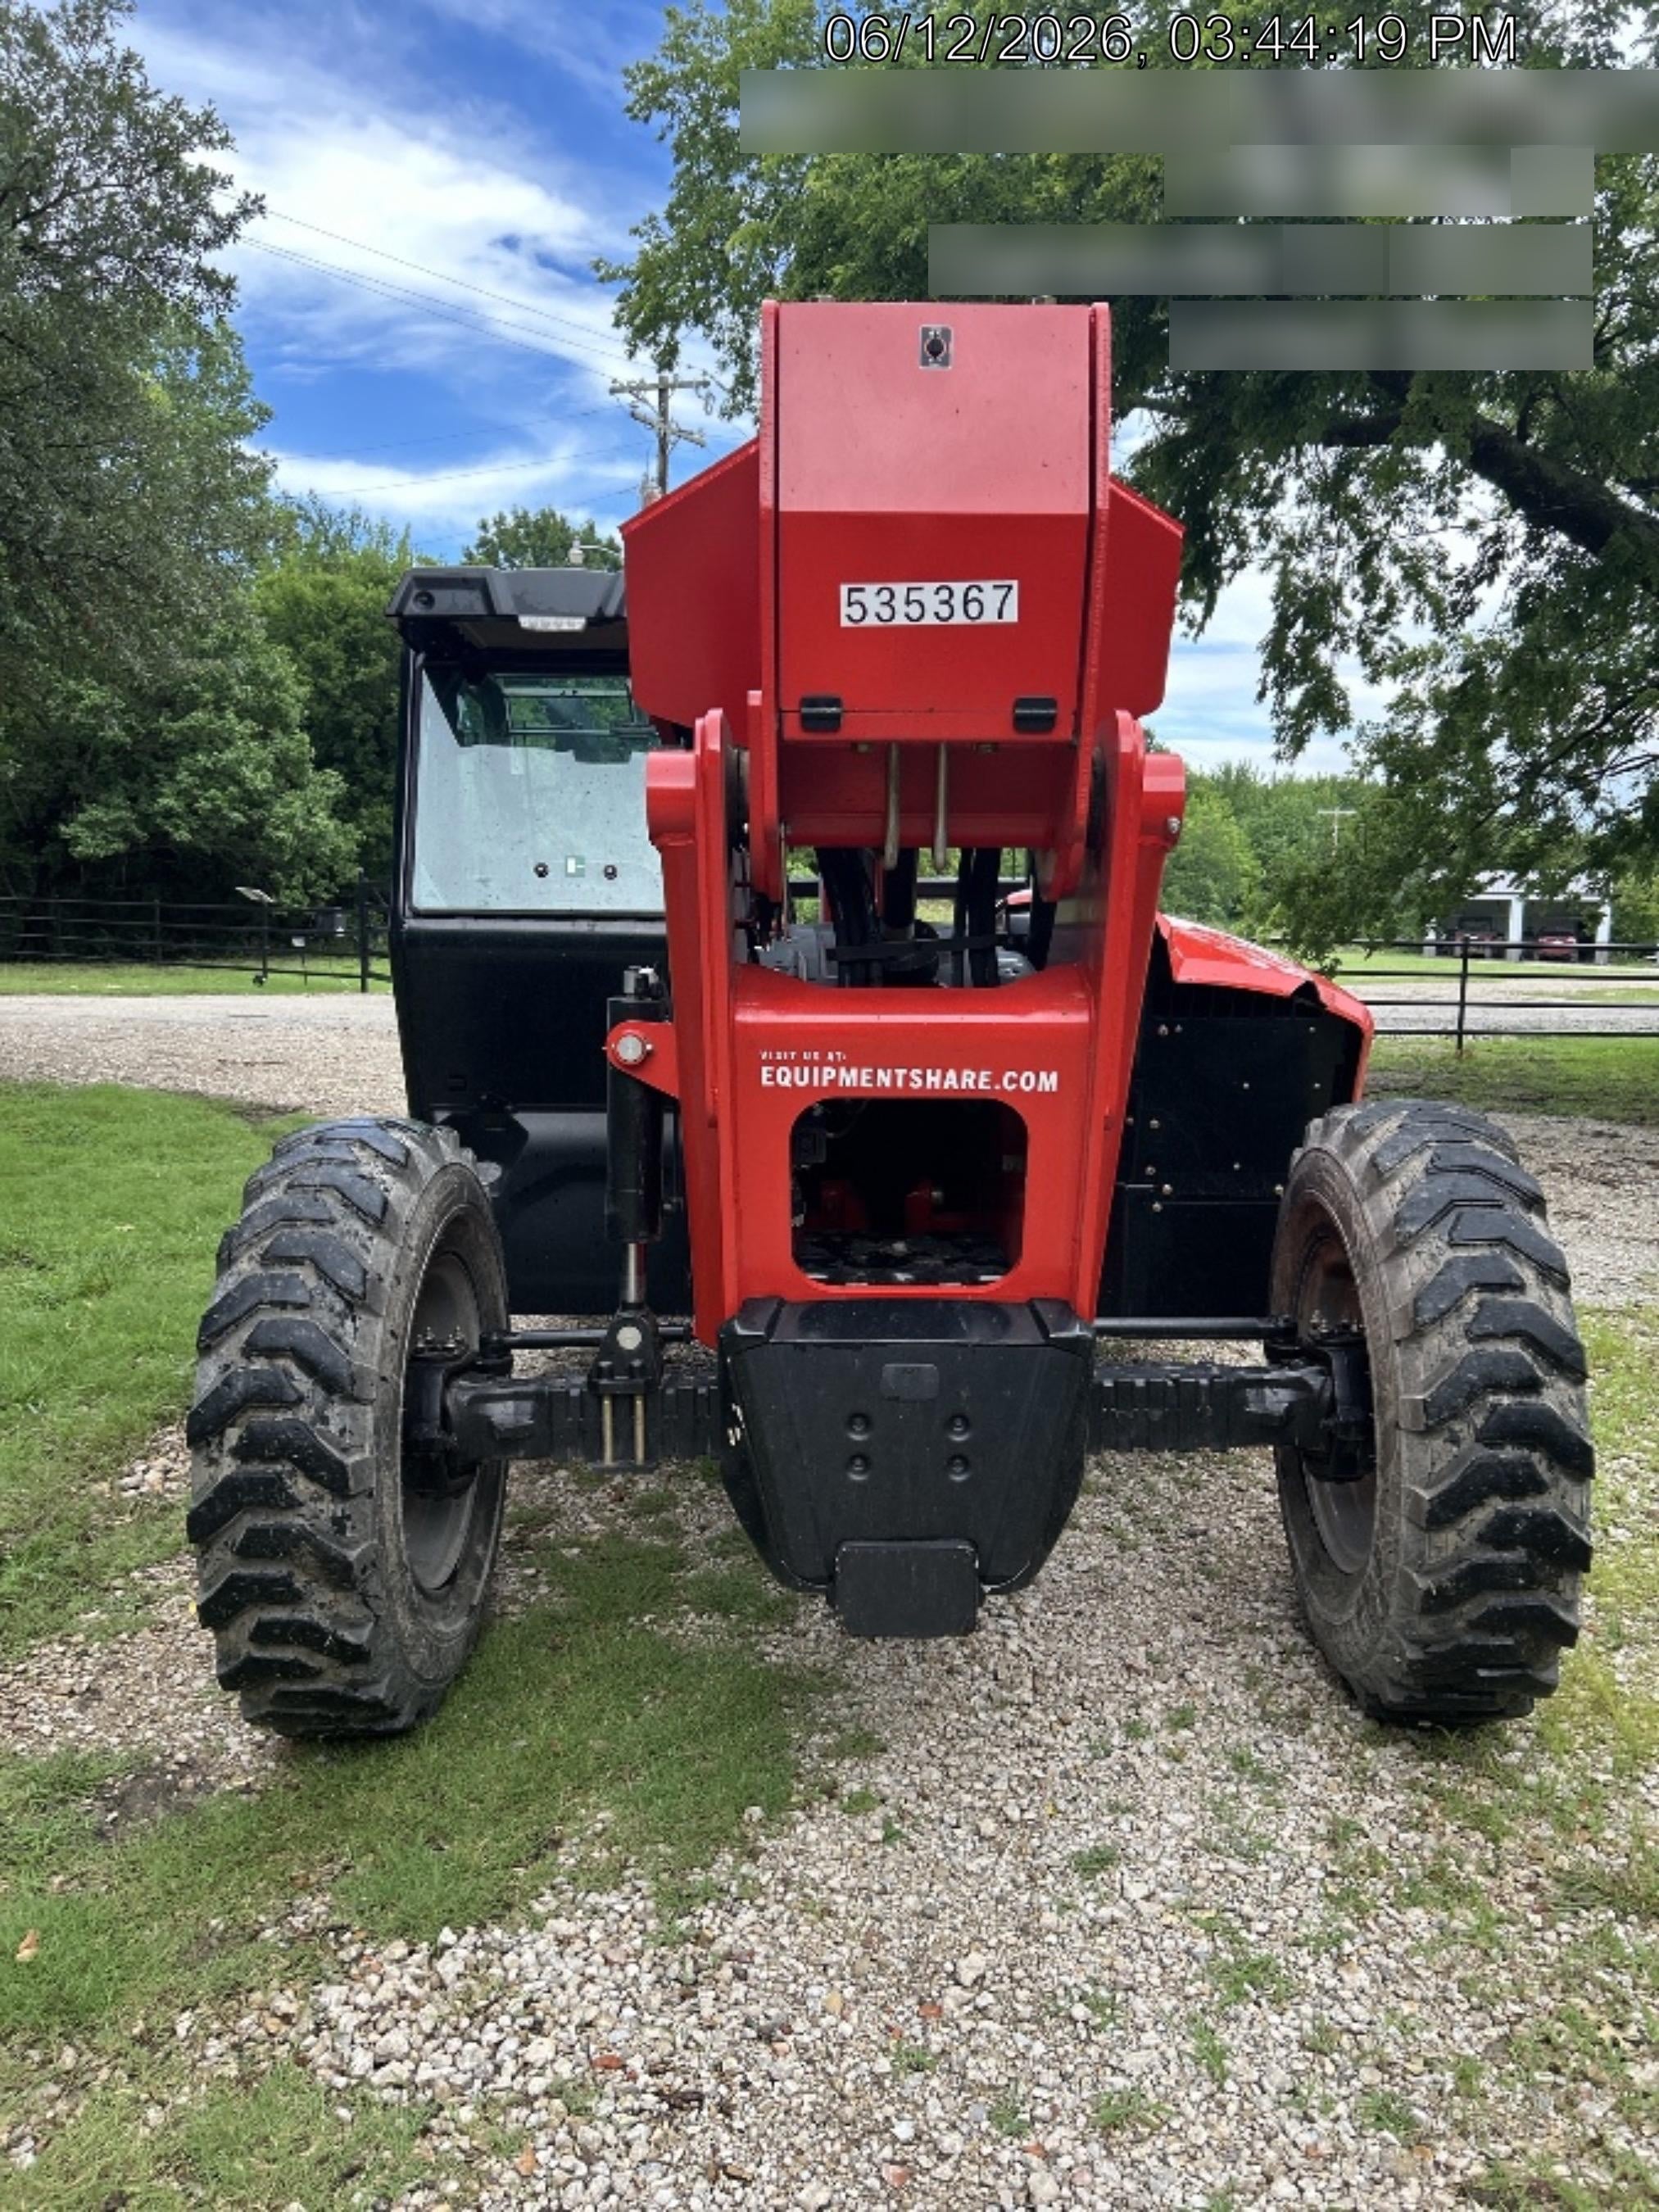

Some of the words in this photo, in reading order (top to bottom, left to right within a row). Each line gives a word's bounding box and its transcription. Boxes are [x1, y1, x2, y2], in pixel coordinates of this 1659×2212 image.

[845, 583, 1013, 623] 535367
[760, 1050, 796, 1061] VISIT
[803, 1050, 820, 1061] US
[827, 1050, 846, 1062] AT:
[760, 1065, 1058, 1093] EQUIPMENTSHARE.COM
